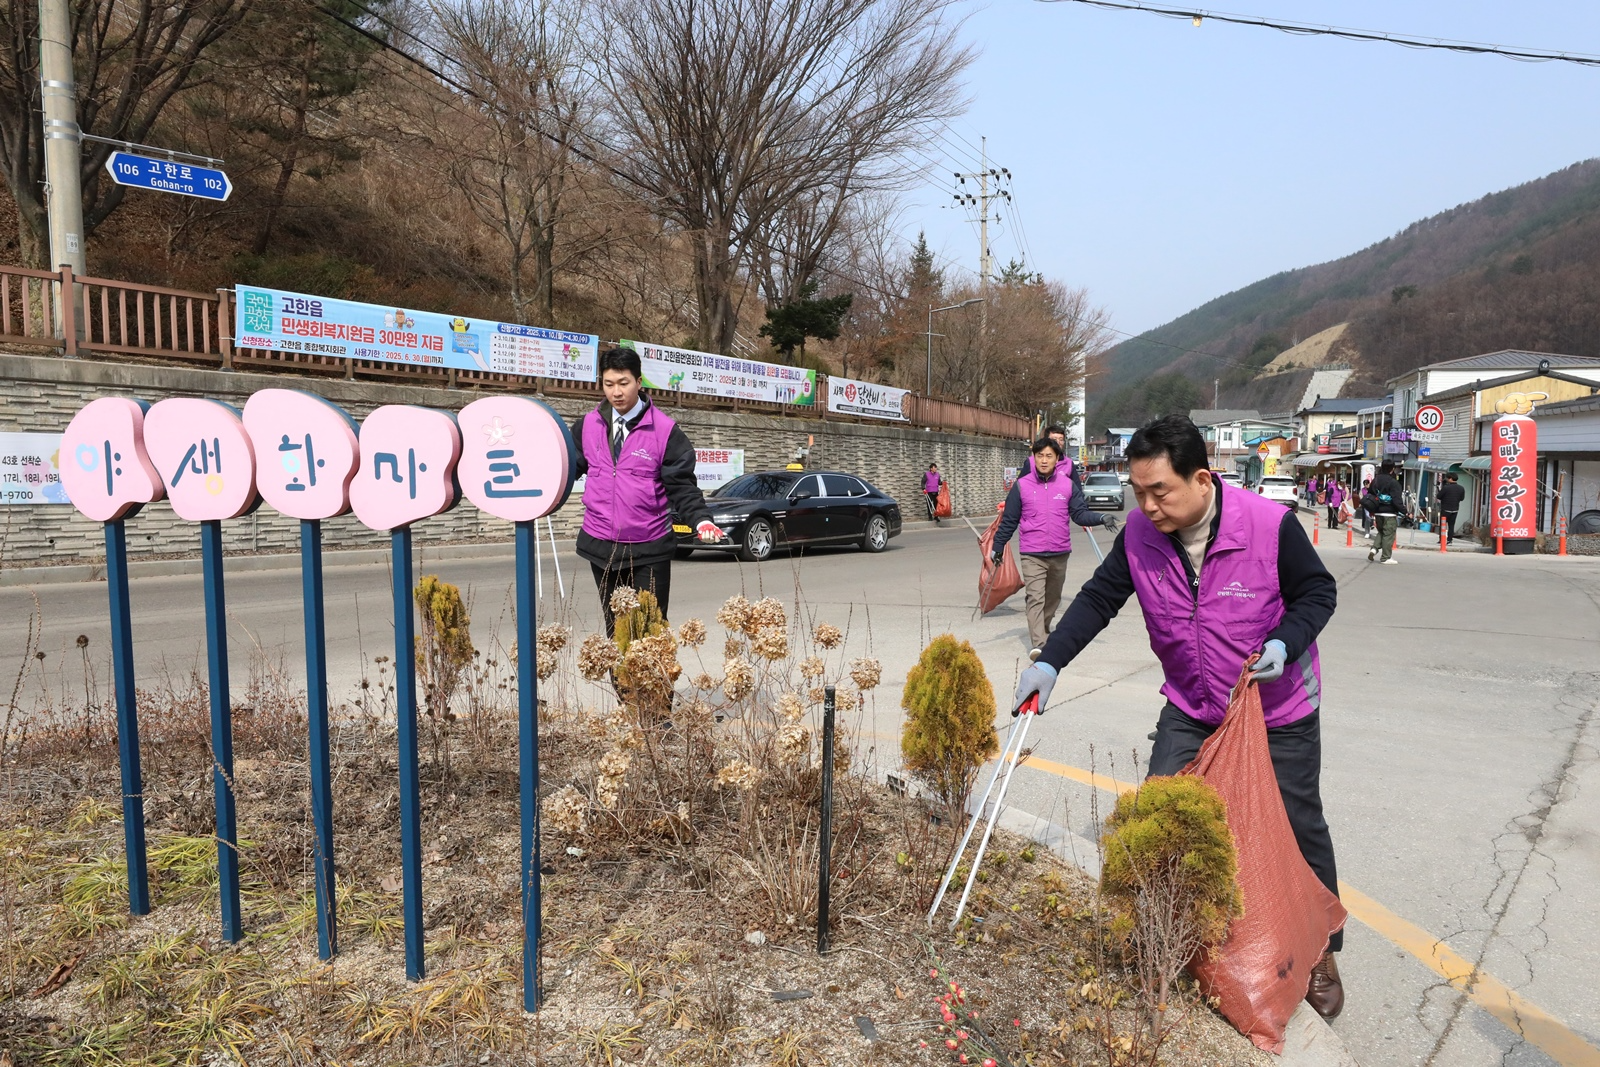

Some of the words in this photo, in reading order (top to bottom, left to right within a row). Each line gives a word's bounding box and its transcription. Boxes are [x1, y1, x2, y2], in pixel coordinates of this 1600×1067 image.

[118, 162, 139, 176] 106
[148, 160, 193, 180] 고한로
[150, 178, 194, 192] Gohan-ro
[204, 178, 222, 190] 102
[246, 293, 273, 308] 국민
[282, 296, 322, 318] 고한읍
[244, 305, 273, 322] 고향
[246, 316, 272, 332] 정선
[501, 325, 521, 334] 신청기간
[527, 328, 540, 337] 2025.
[282, 317, 374, 344] 민생회복지원금
[379, 330, 418, 348] 30만원
[421, 335, 444, 351] 지급
[242, 336, 272, 347] 신청장소
[280, 340, 302, 350] 고한읍
[304, 342, 346, 354] 종합복지회관
[354, 348, 380, 358] 사용기한
[386, 352, 403, 360] 2025.
[644, 347, 662, 360] 제21대
[664, 350, 702, 366] 고한읍번영회와
[703, 356, 713, 368] 지역
[715, 359, 730, 370] 발전을
[731, 360, 741, 372] 위해
[742, 362, 751, 374] 함께
[692, 371, 713, 382] 모집기간
[720, 375, 737, 385] 2025년
[858, 385, 880, 405] 닭갈비
[1422, 412, 1437, 425] 30
[1500, 424, 1522, 461] 먹빵
[2, 455, 18, 465] 43호
[21, 455, 41, 466] 선착순
[3, 473, 22, 483] 17리,
[24, 473, 42, 483] 18리,
[1494, 528, 1529, 536] 51-5505
